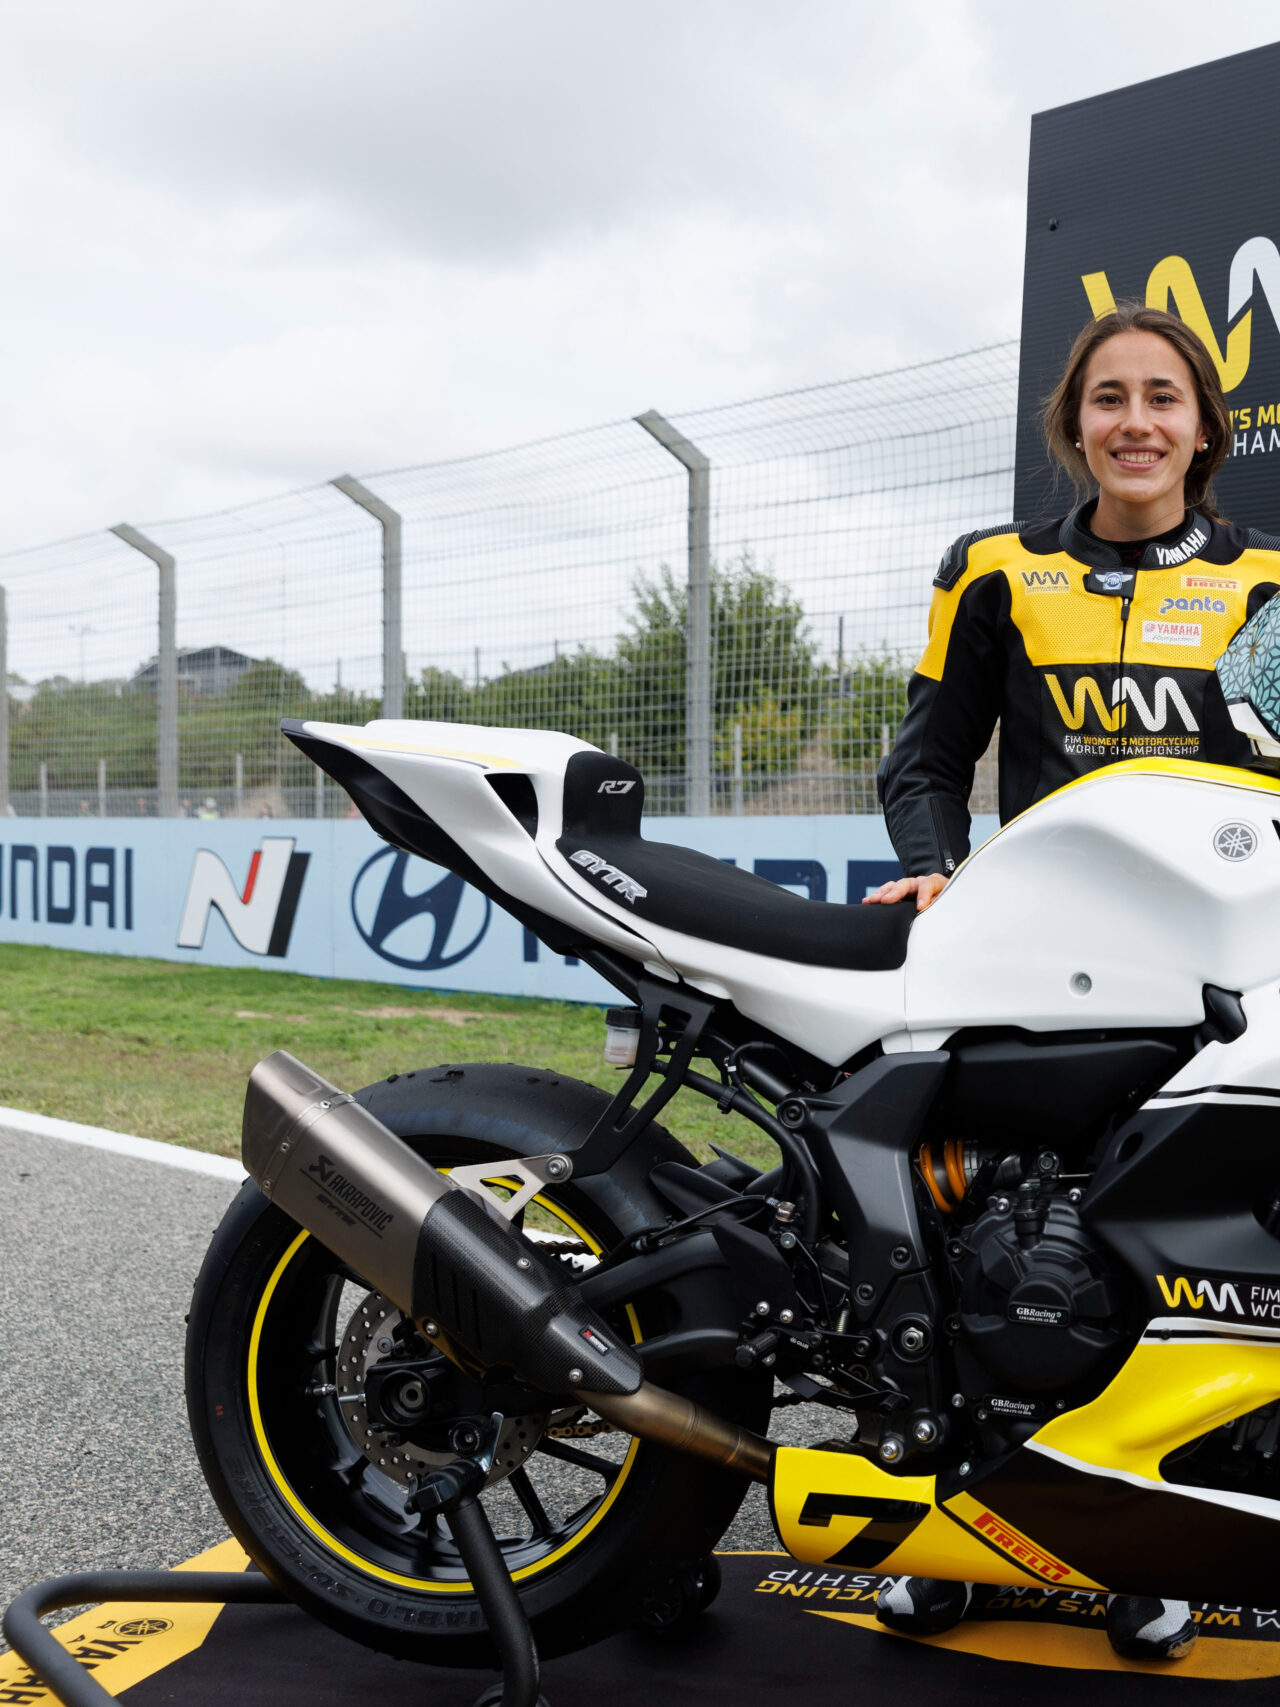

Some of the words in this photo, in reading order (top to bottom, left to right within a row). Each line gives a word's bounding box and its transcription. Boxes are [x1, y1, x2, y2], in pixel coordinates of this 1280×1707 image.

[1155, 527, 1207, 566] YAMAHA
[1186, 577, 1238, 589] PIRELLI
[1160, 596, 1226, 614] panta
[1157, 623, 1200, 636] YAMAHA
[1064, 735, 1082, 745] FIM
[1129, 737, 1200, 746] MOTORCYCLING
[1064, 744, 1105, 755] WORLD
[1110, 745, 1199, 755] CHAMPIONSHIP
[597, 780, 637, 794] R7
[568, 849, 648, 905] GYTR
[0, 843, 134, 930] NDAI
[1251, 1286, 1280, 1303] FIM
[798, 1492, 932, 1569] 7
[972, 1511, 1071, 1581] PIRELLI
[365, 1597, 484, 1627] IABLO
